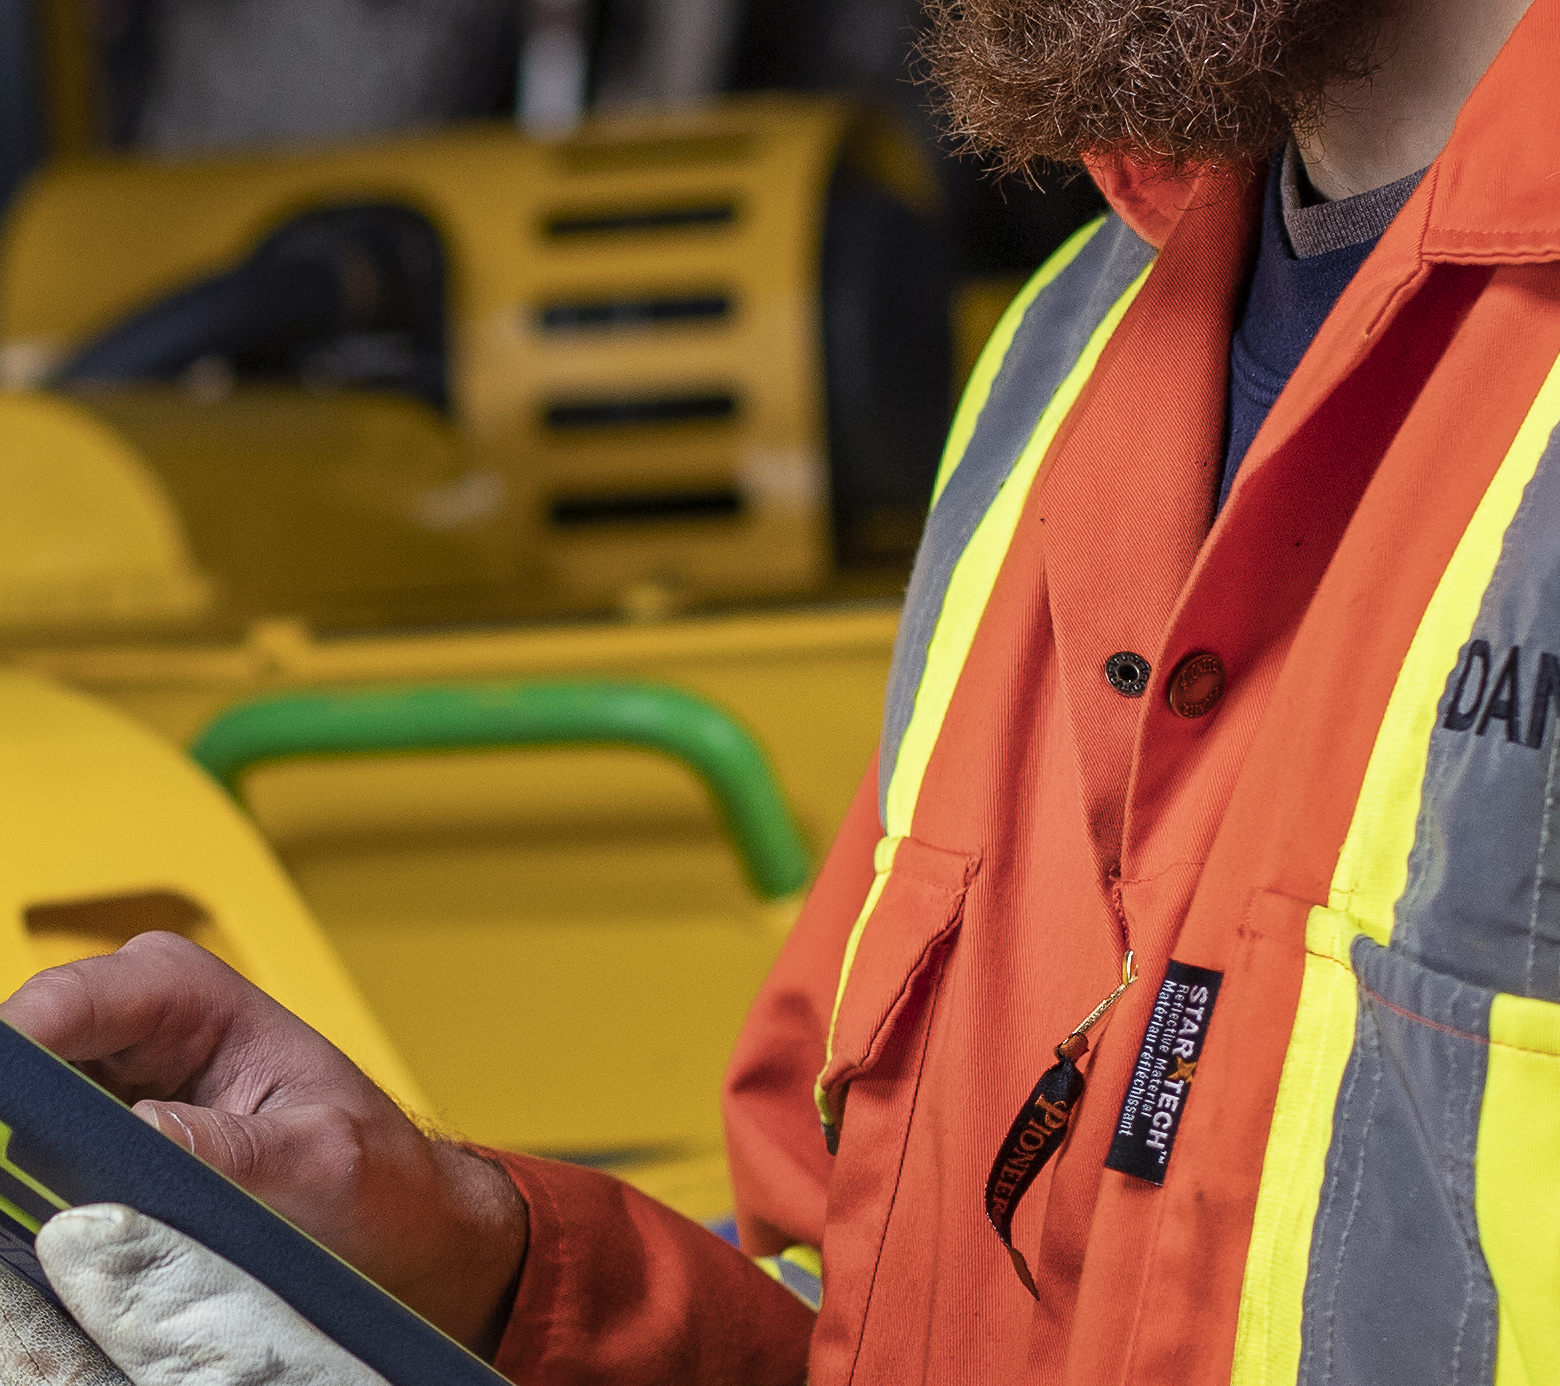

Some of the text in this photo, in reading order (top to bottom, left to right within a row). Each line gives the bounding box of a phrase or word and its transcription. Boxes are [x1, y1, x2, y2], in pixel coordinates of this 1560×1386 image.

[1140, 983, 1190, 1118] Reflective Material
[1171, 985, 1209, 1059] STAR
[992, 1093, 1068, 1214] PIONEER
